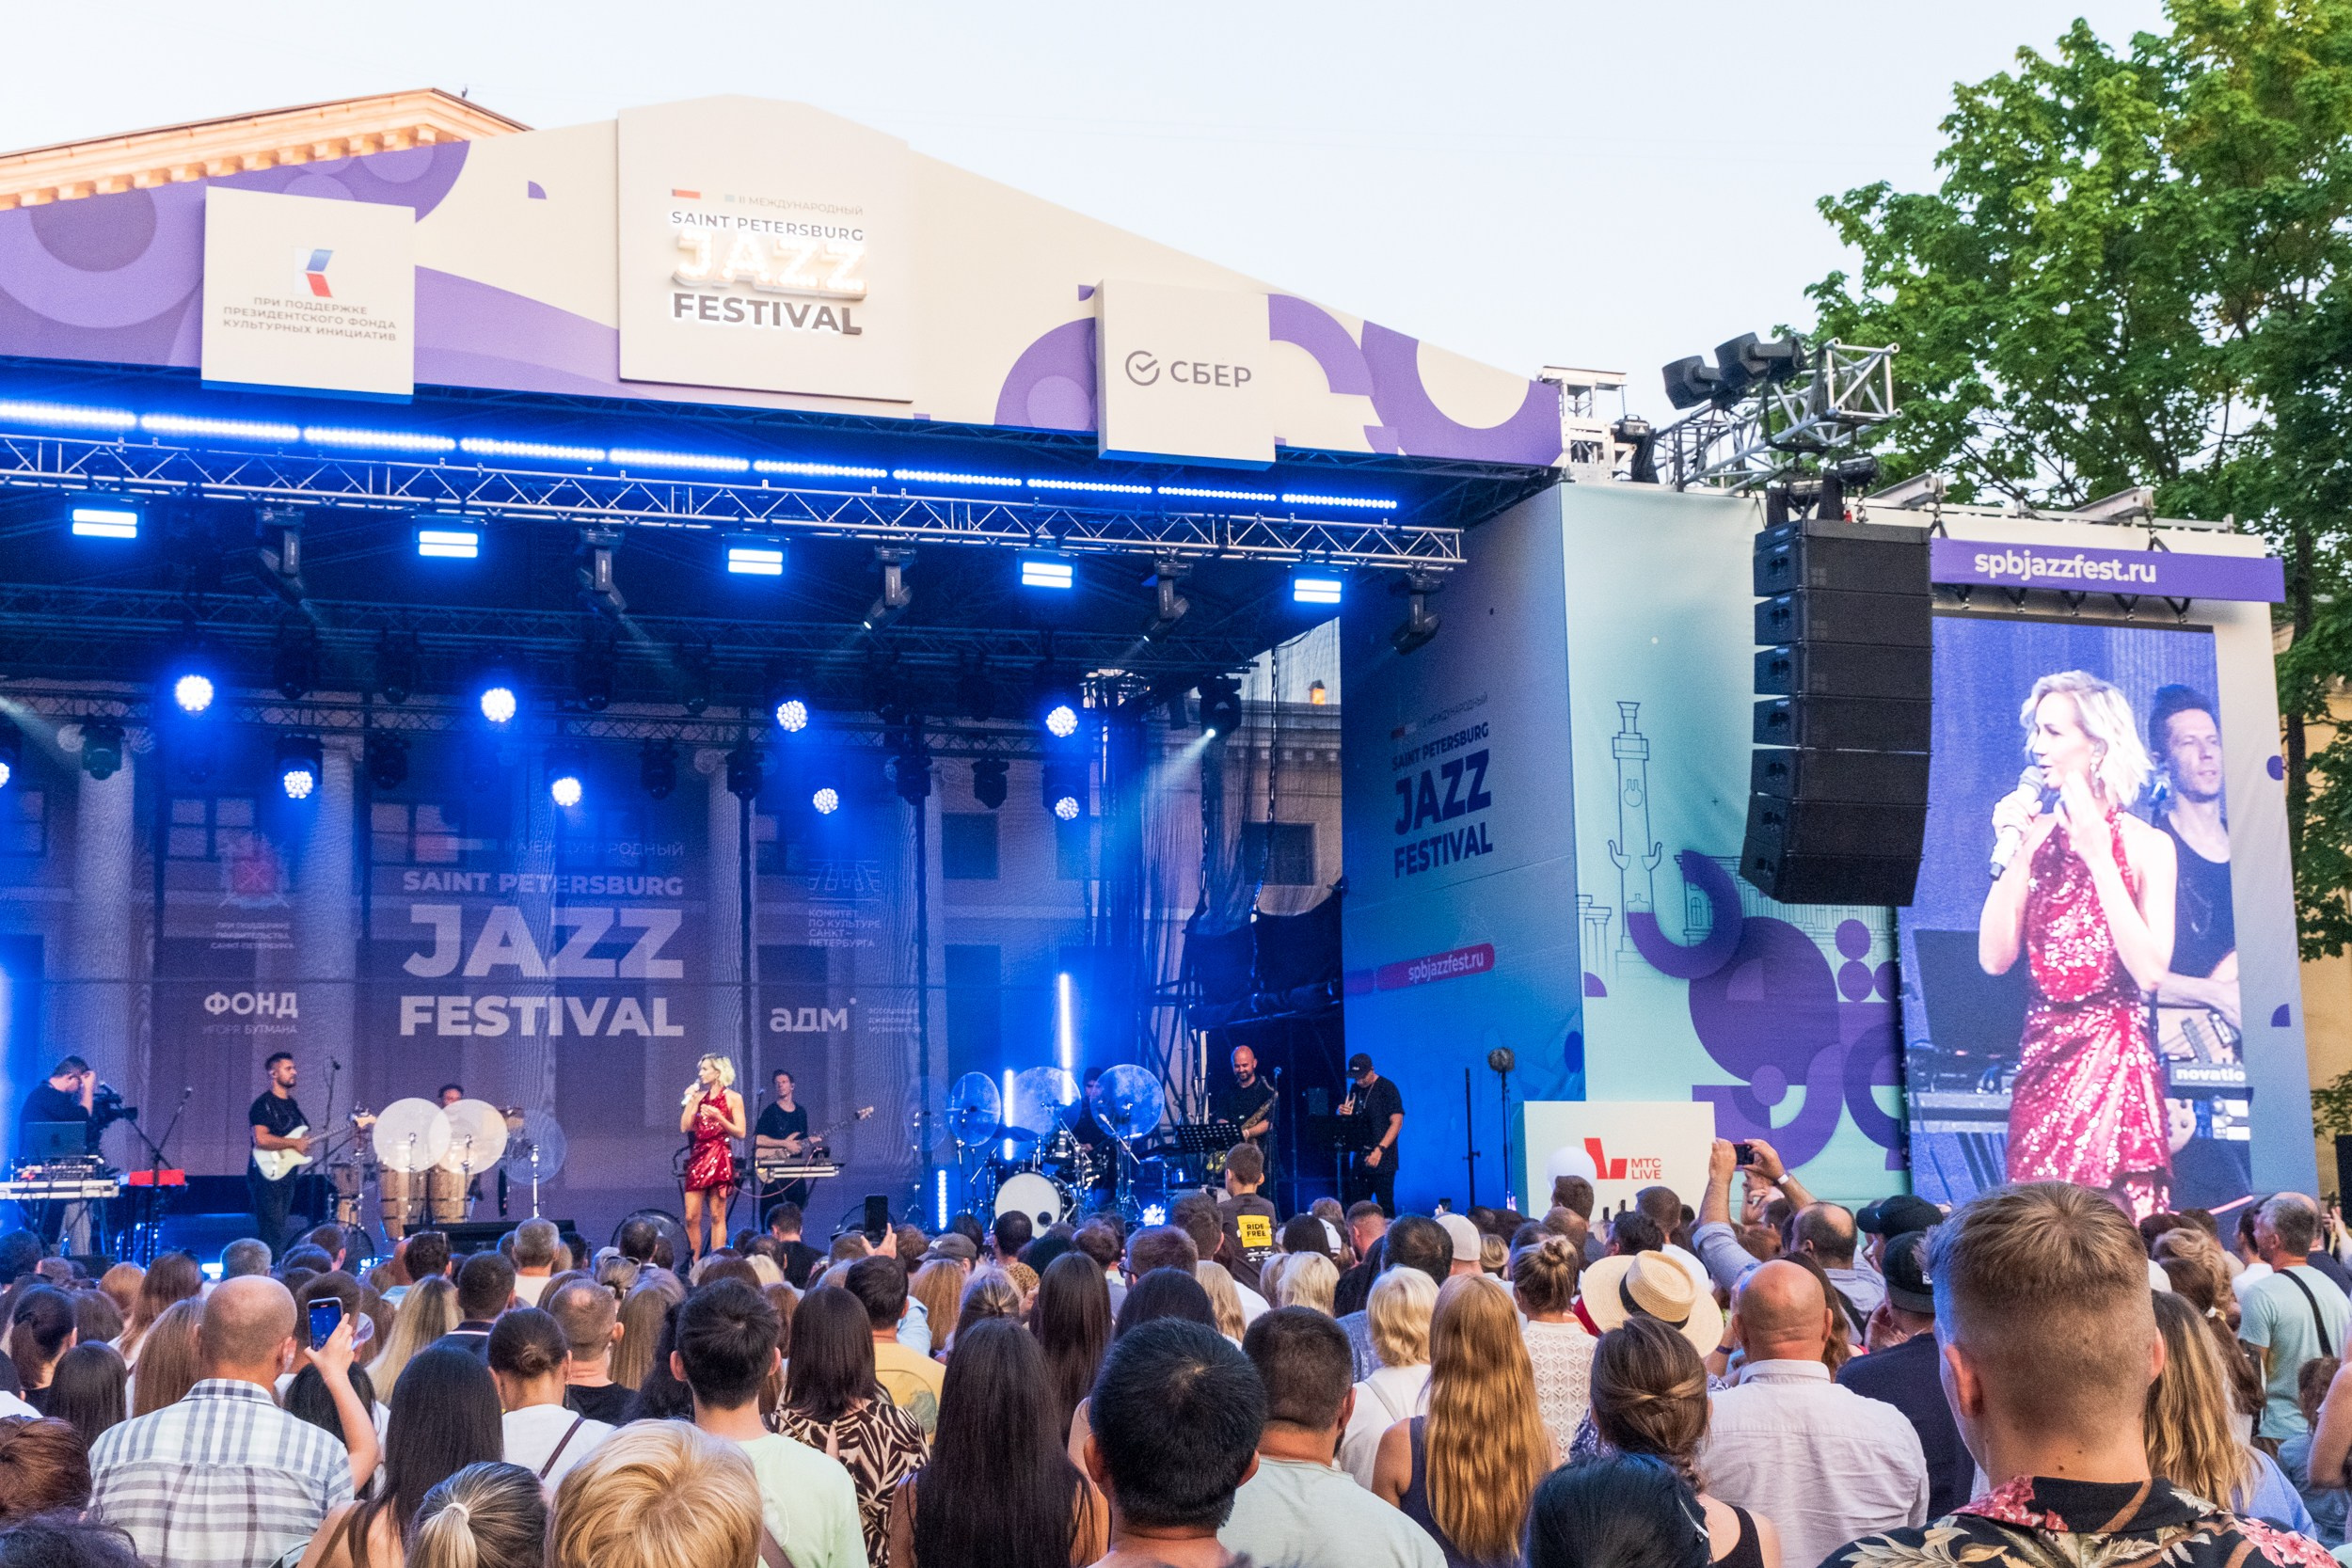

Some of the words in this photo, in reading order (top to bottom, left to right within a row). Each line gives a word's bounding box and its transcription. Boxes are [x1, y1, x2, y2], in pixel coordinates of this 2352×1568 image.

[749, 196, 863, 216] МЕЖДУНАРОДНЫЙ
[672, 211, 730, 229] SAINT
[737, 217, 864, 242] PETERSBURG
[672, 230, 867, 301] JAZZ
[223, 306, 344, 325] ПРЕЗИДЕНТСКОГО
[348, 317, 396, 329] ФОНДА
[254, 296, 280, 308] ПРИ
[285, 299, 367, 315] ПОДДЕРЖКЕ
[674, 293, 863, 335] FESTIVAL
[223, 319, 311, 335] КУЛЬТУРНЫХ
[316, 326, 396, 341] ИНИЦИАТИВ
[1170, 360, 1251, 388] СБЕР
[1975, 549, 2156, 583] spbjazzfest.ru
[1392, 747, 1421, 771] SAINT
[1422, 721, 1489, 760] PETERSBURG
[1394, 749, 1492, 836] JAZZ
[1393, 821, 1493, 879] FESTIVAL
[403, 870, 491, 892] SAINT
[500, 872, 684, 895] PETERSBURG
[808, 909, 859, 918] КОМИТЕТ
[808, 918, 825, 927] ПО
[828, 919, 882, 929] КУЛЬТУРЕ
[402, 903, 684, 978] JAZZ
[808, 938, 875, 947] ПЕТЕРБУРГА
[1407, 949, 1485, 984] spbjazzfest.ru
[204, 991, 298, 1019] ФОНД
[400, 994, 684, 1037] FESTIVAL
[1631, 1169, 1662, 1180] LIVE
